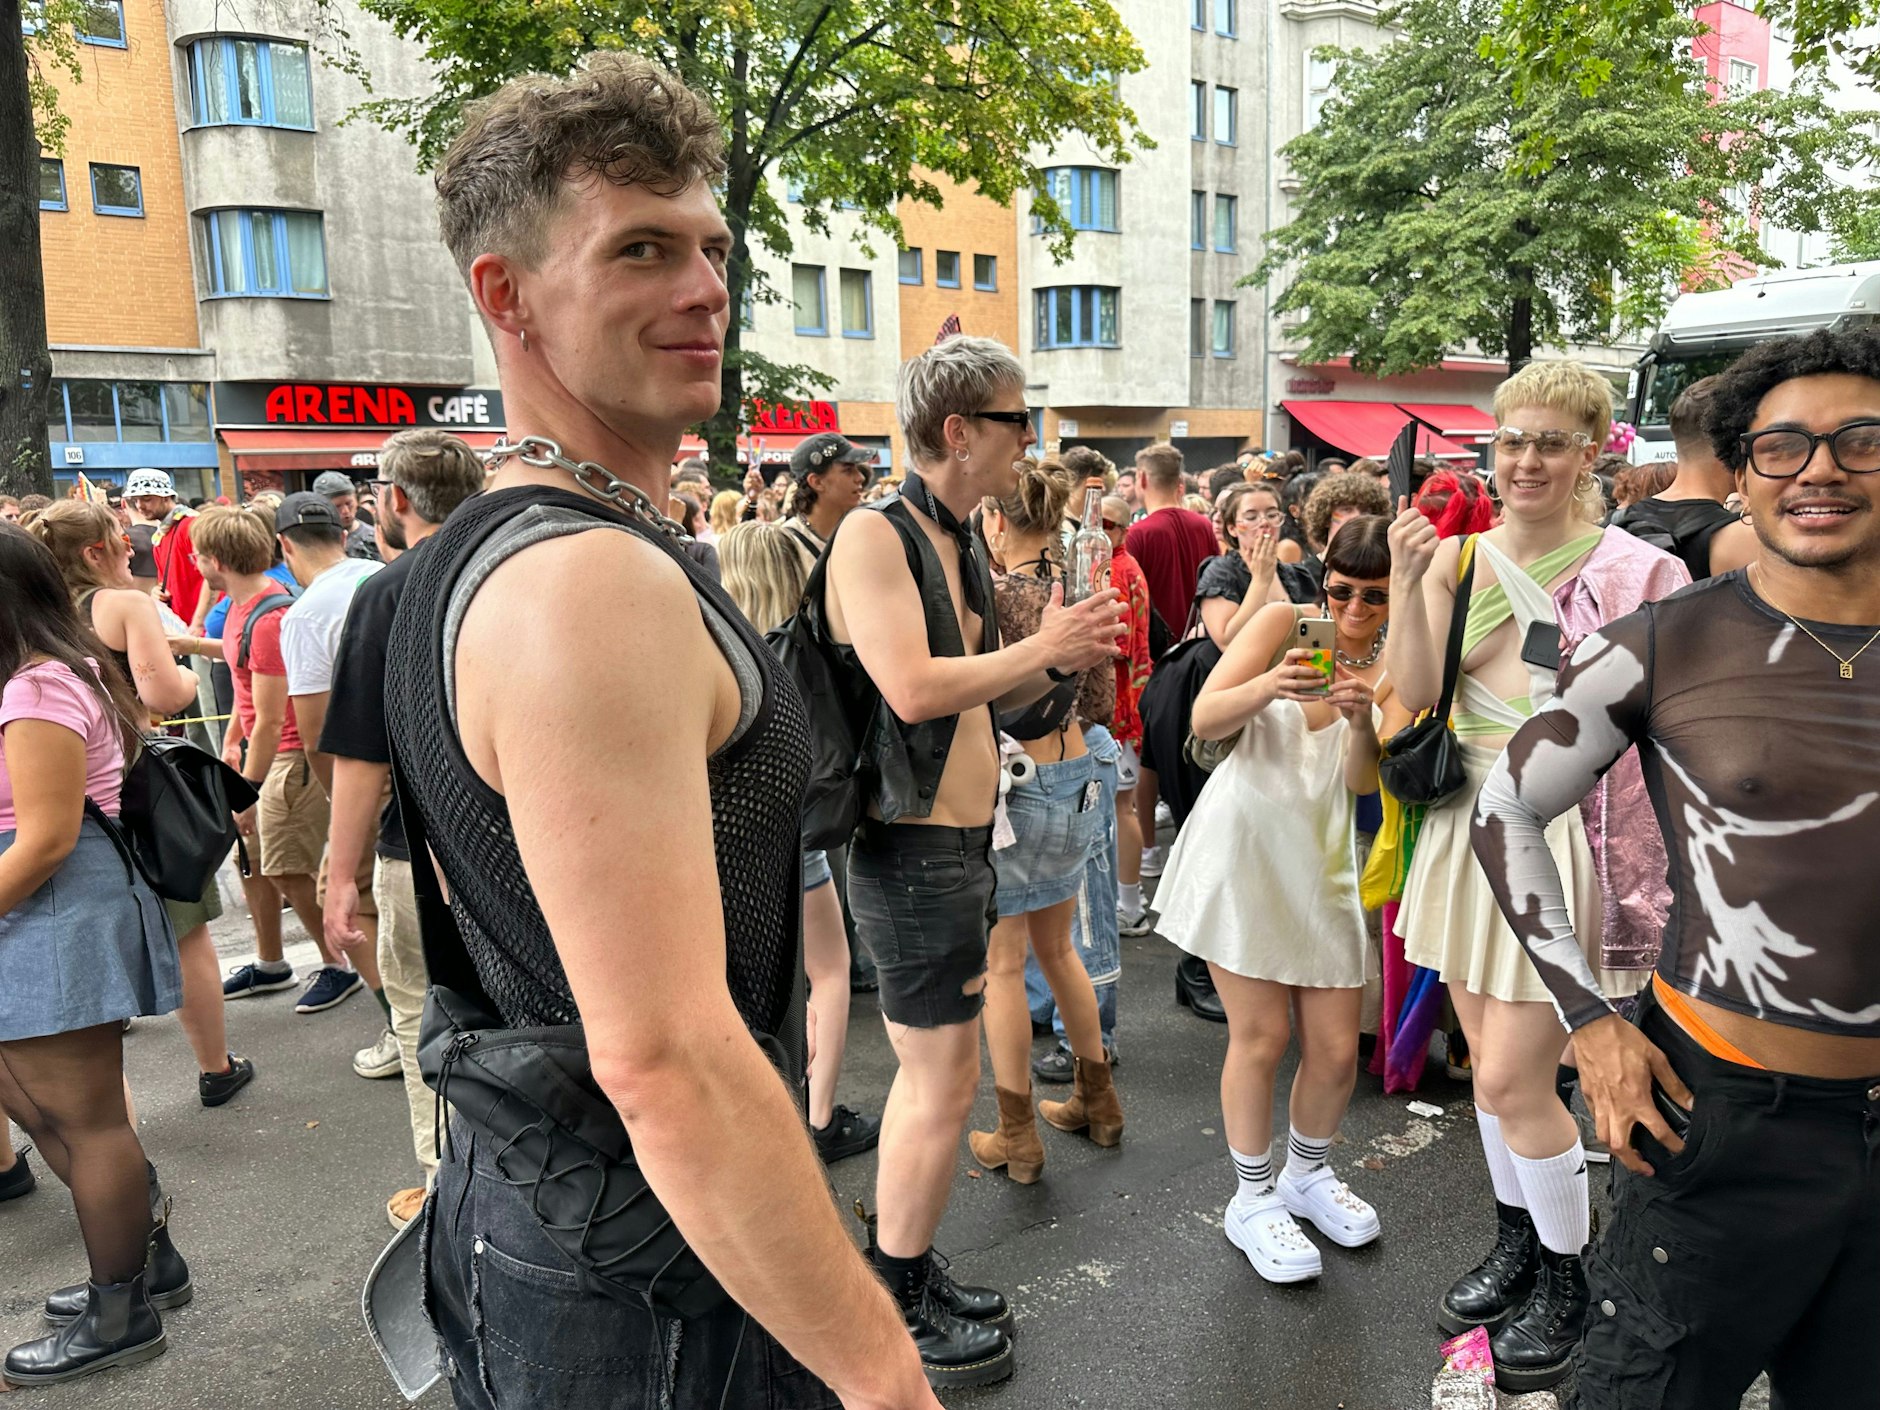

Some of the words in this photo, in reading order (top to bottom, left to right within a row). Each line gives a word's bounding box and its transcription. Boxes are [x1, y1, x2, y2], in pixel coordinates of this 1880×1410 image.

[265, 385, 416, 424] ARENA
[428, 394, 490, 424] CAFÉ
[67, 451, 82, 460] 106
